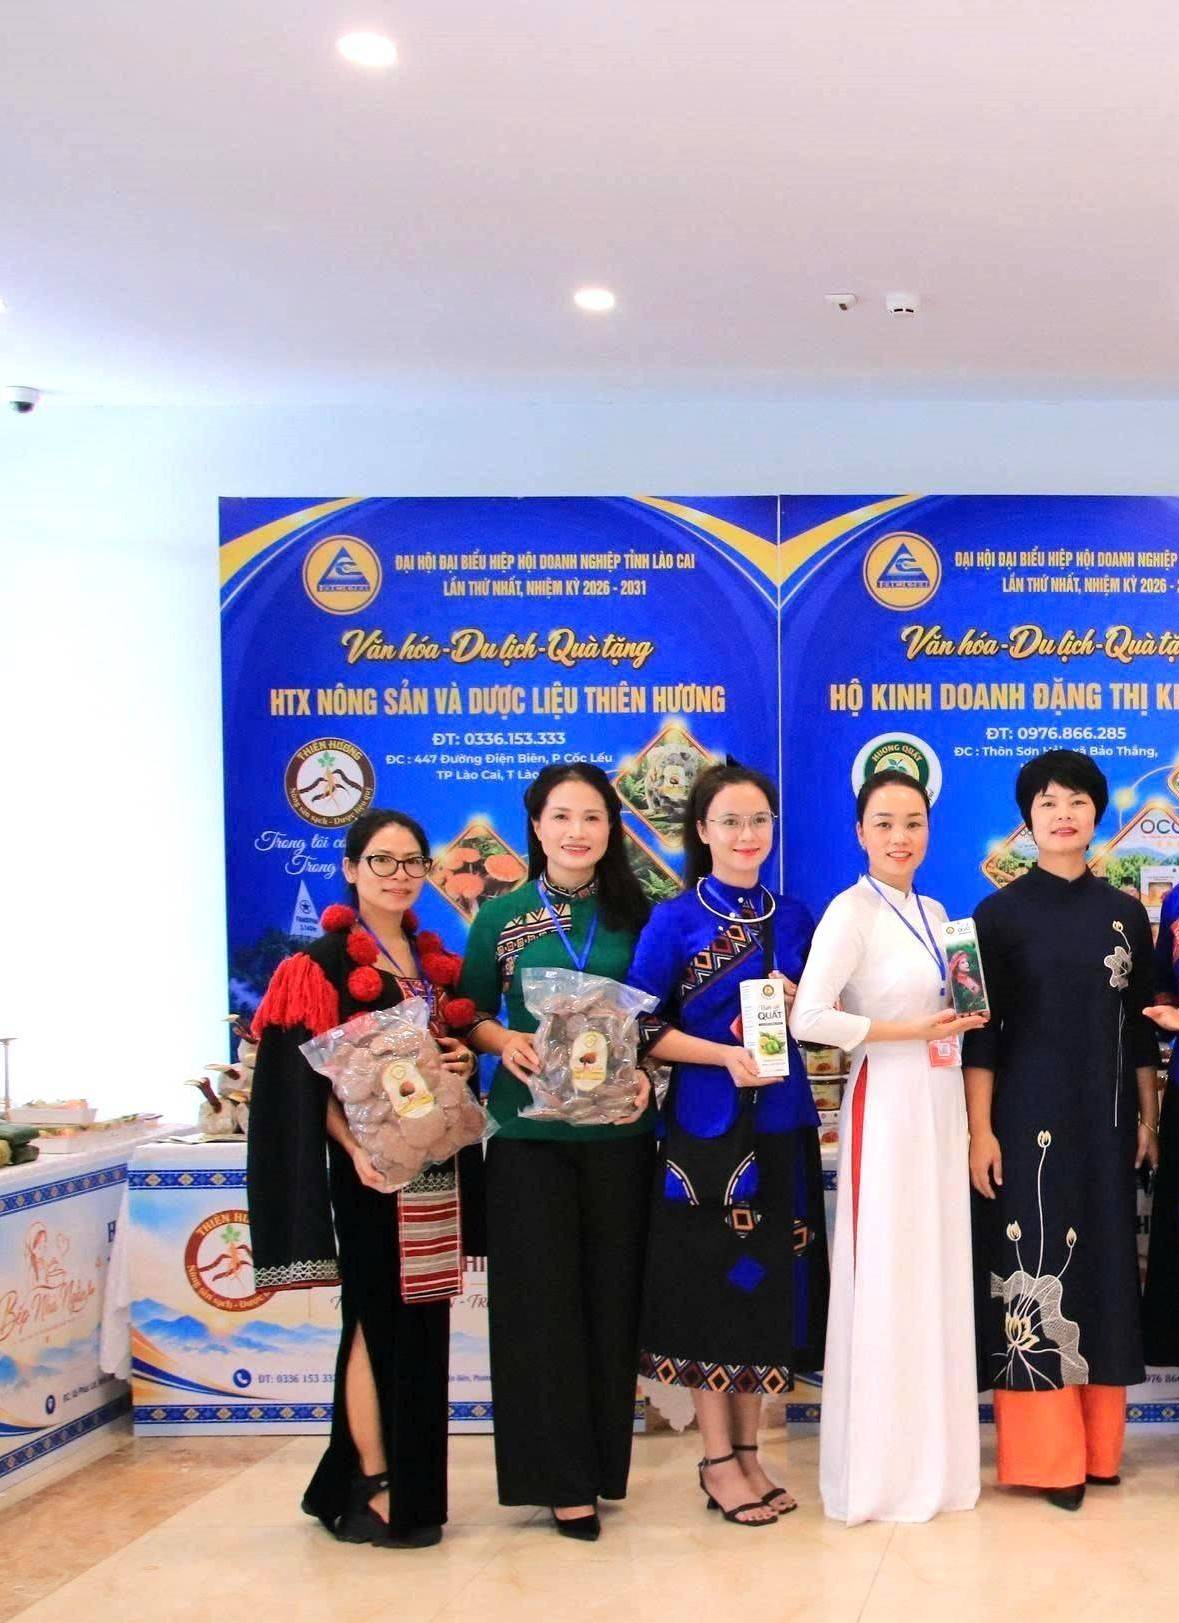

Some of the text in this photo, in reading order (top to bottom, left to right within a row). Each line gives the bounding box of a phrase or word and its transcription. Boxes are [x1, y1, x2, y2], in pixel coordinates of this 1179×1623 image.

[395, 548, 695, 574] ĐẠI HỘI ĐẠI BIỂU HIỆP HỘI DOANH NGHIỆP TỈNH LÀO CAI
[954, 551, 973, 570] ĐẠI
[977, 548, 995, 570] HỘI
[998, 551, 1017, 570] ĐẠI
[1020, 546, 1044, 567] BIỂU
[1048, 548, 1072, 570] HIỆP
[1076, 549, 1094, 570] HỘI
[1097, 552, 1135, 568] DOANH
[1137, 549, 1177, 571] NGHIỆP
[443, 575, 647, 599] LẦN THỨ NHẤT, NHIỆM KỲ 2026 2031
[1003, 573, 1024, 593] LẦN
[1026, 574, 1049, 593] THỨ
[1051, 573, 1082, 595] NHẤT,
[1085, 574, 1120, 596] NHIỆM
[1123, 575, 1138, 593] KỲ
[1140, 578, 1167, 593] 2026
[340, 628, 397, 665] Văn
[602, 633, 654, 669] tặng
[270, 679, 726, 720] HTX NÔNG SẢN VÀ DƯỢC LIỆU THIÊN HƯƠNG
[830, 678, 863, 717] HỘ
[871, 683, 932, 711] KINH
[940, 683, 1025, 710] DOANH
[1033, 677, 1102, 716] ĐẶNG
[1109, 683, 1148, 716] THỊ
[432, 732, 566, 746] ĐT: 0336.153.333
[986, 727, 1127, 740] ĐT: 0976.866.285
[414, 754, 437, 764] 447
[440, 753, 482, 766] Đường
[485, 753, 514, 766] Điện
[518, 753, 549, 765] Biên,
[552, 753, 561, 763] P
[564, 752, 587, 764] Cốc
[591, 751, 613, 763] Lếu
[982, 745, 1012, 757] Thôn
[1015, 746, 1039, 757] Sơn
[1090, 745, 1113, 757] Bảo
[1116, 745, 1158, 758] Thắng,
[436, 770, 453, 780] TP
[456, 769, 478, 780] Lào
[481, 770, 504, 781] Cai,
[507, 770, 514, 779] T
